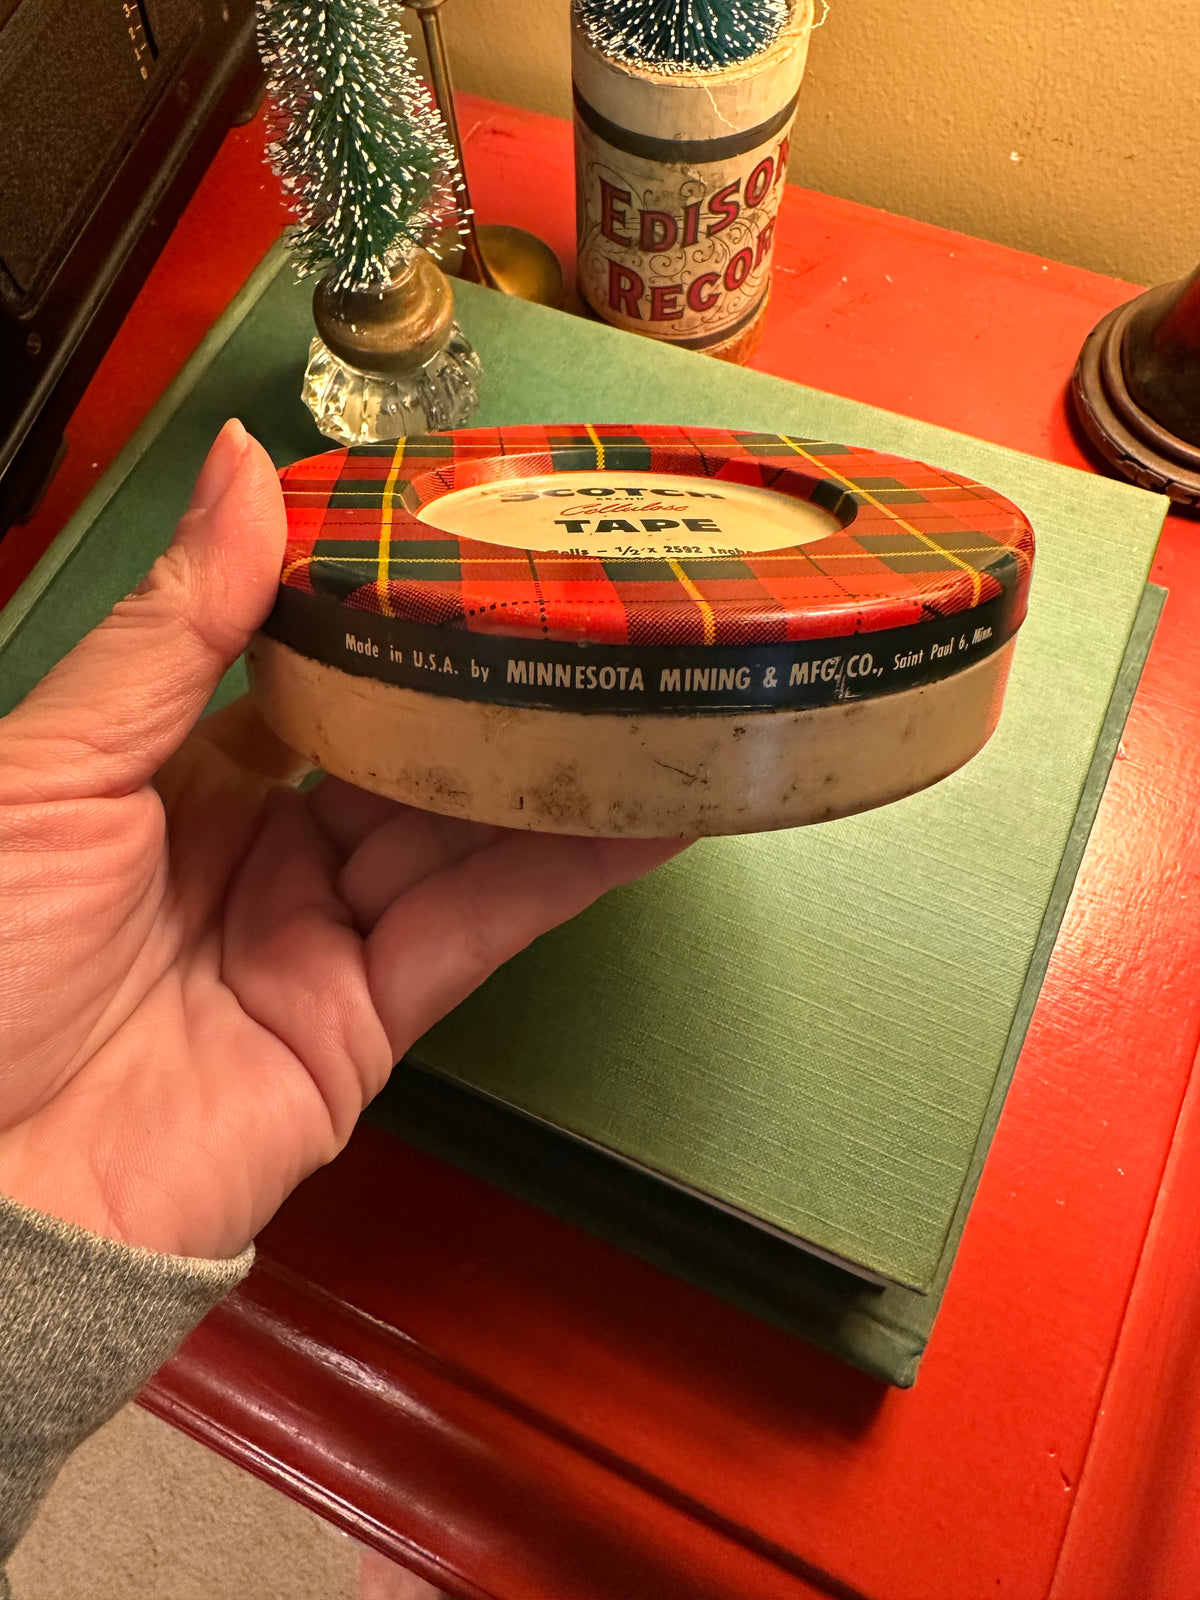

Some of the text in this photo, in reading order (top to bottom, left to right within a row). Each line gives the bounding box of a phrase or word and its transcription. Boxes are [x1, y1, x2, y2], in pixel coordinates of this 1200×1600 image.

[500, 487, 726, 503] SCOTCH
[560, 501, 690, 516] Cellulose
[553, 518, 722, 534] TAPE
[663, 545, 703, 554] 2592
[345, 632, 380, 658] Made
[389, 644, 403, 664] in
[412, 650, 460, 676] U.S.A.
[470, 659, 490, 683] by
[506, 658, 645, 692] MINNESOTA
[659, 665, 751, 692] MINING
[762, 666, 778, 689] &
[846, 652, 884, 678] CO.,
[893, 649, 925, 671] Saint
[930, 637, 955, 661] Paul
[958, 633, 969, 650] 6,
[971, 626, 993, 645] Minn.
